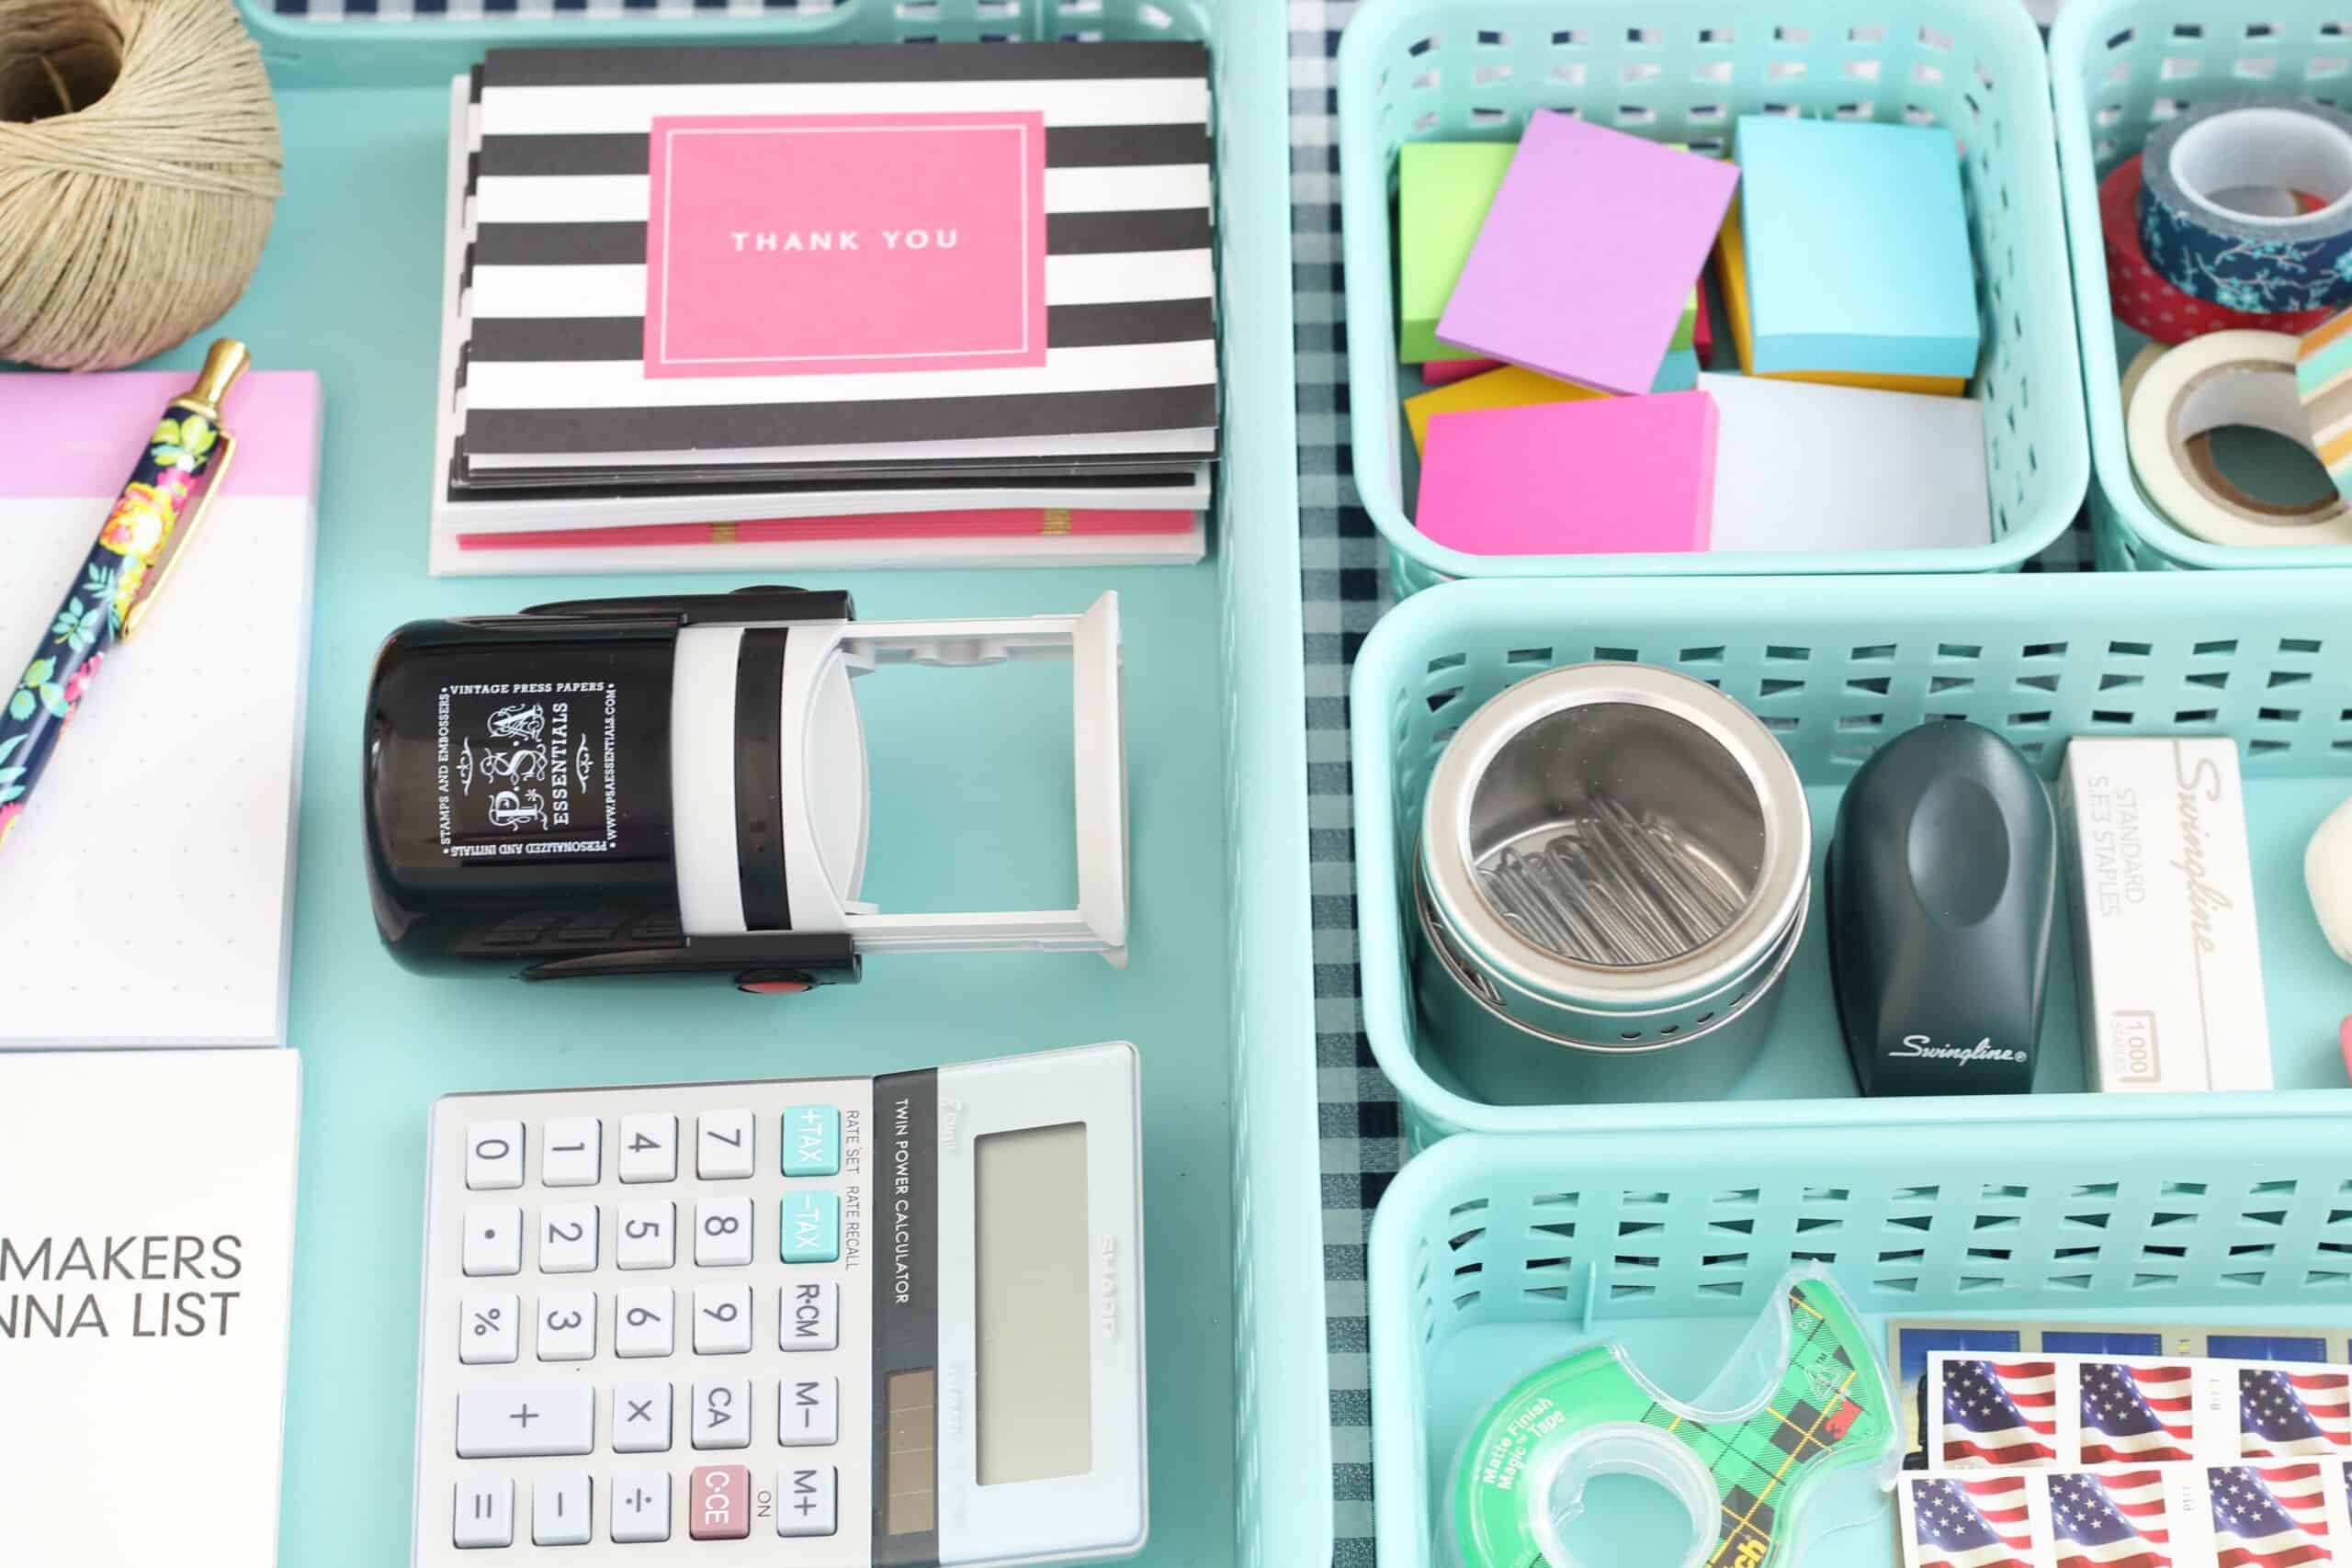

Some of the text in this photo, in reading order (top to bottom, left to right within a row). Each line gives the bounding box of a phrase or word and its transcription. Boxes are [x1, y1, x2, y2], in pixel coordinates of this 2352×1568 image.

[730, 229, 957, 252] THANK YOU
[450, 682, 605, 694] VINTAGE PRESS PAPERS
[438, 693, 451, 845] STAMPS AND EMBOSSERS
[552, 702, 569, 826] ESSENTIALS
[604, 689, 617, 840] WWW.PSAESSENTIALS.COM
[450, 840, 607, 857] PERSONALIZED AND INITIALS
[2115, 787, 2145, 905] STANDARD
[2170, 744, 2234, 955] Swingline
[2093, 829, 2122, 919] STAPLES
[476, 1139, 509, 1160] 0
[551, 1141, 585, 1152] 1
[628, 1132, 662, 1154] 4
[707, 1128, 741, 1147] 7
[800, 1110, 823, 1163] +TAX
[846, 1110, 860, 1175] RATE SET
[894, 1098, 910, 1304] TWIN POWER CALCULATOR
[550, 1223, 583, 1244] 2
[626, 1219, 660, 1239] 5
[705, 1216, 739, 1236] 8
[845, 1185, 860, 1271] RATE RECALL
[0, 1235, 242, 1281] MAKERS
[132, 1292, 241, 1337] LIST
[474, 1307, 502, 1337] %
[548, 1311, 582, 1332] 3
[627, 1307, 662, 1326] 6
[703, 1303, 738, 1322] 9
[707, 1387, 732, 1428] CA
[1527, 1410, 1566, 1439] Tape
[1825, 1398, 1865, 1439] 3M
[1483, 1397, 1555, 1484] Matte Finish
[757, 1491, 772, 1517] ON
[794, 1470, 818, 1517] M+
